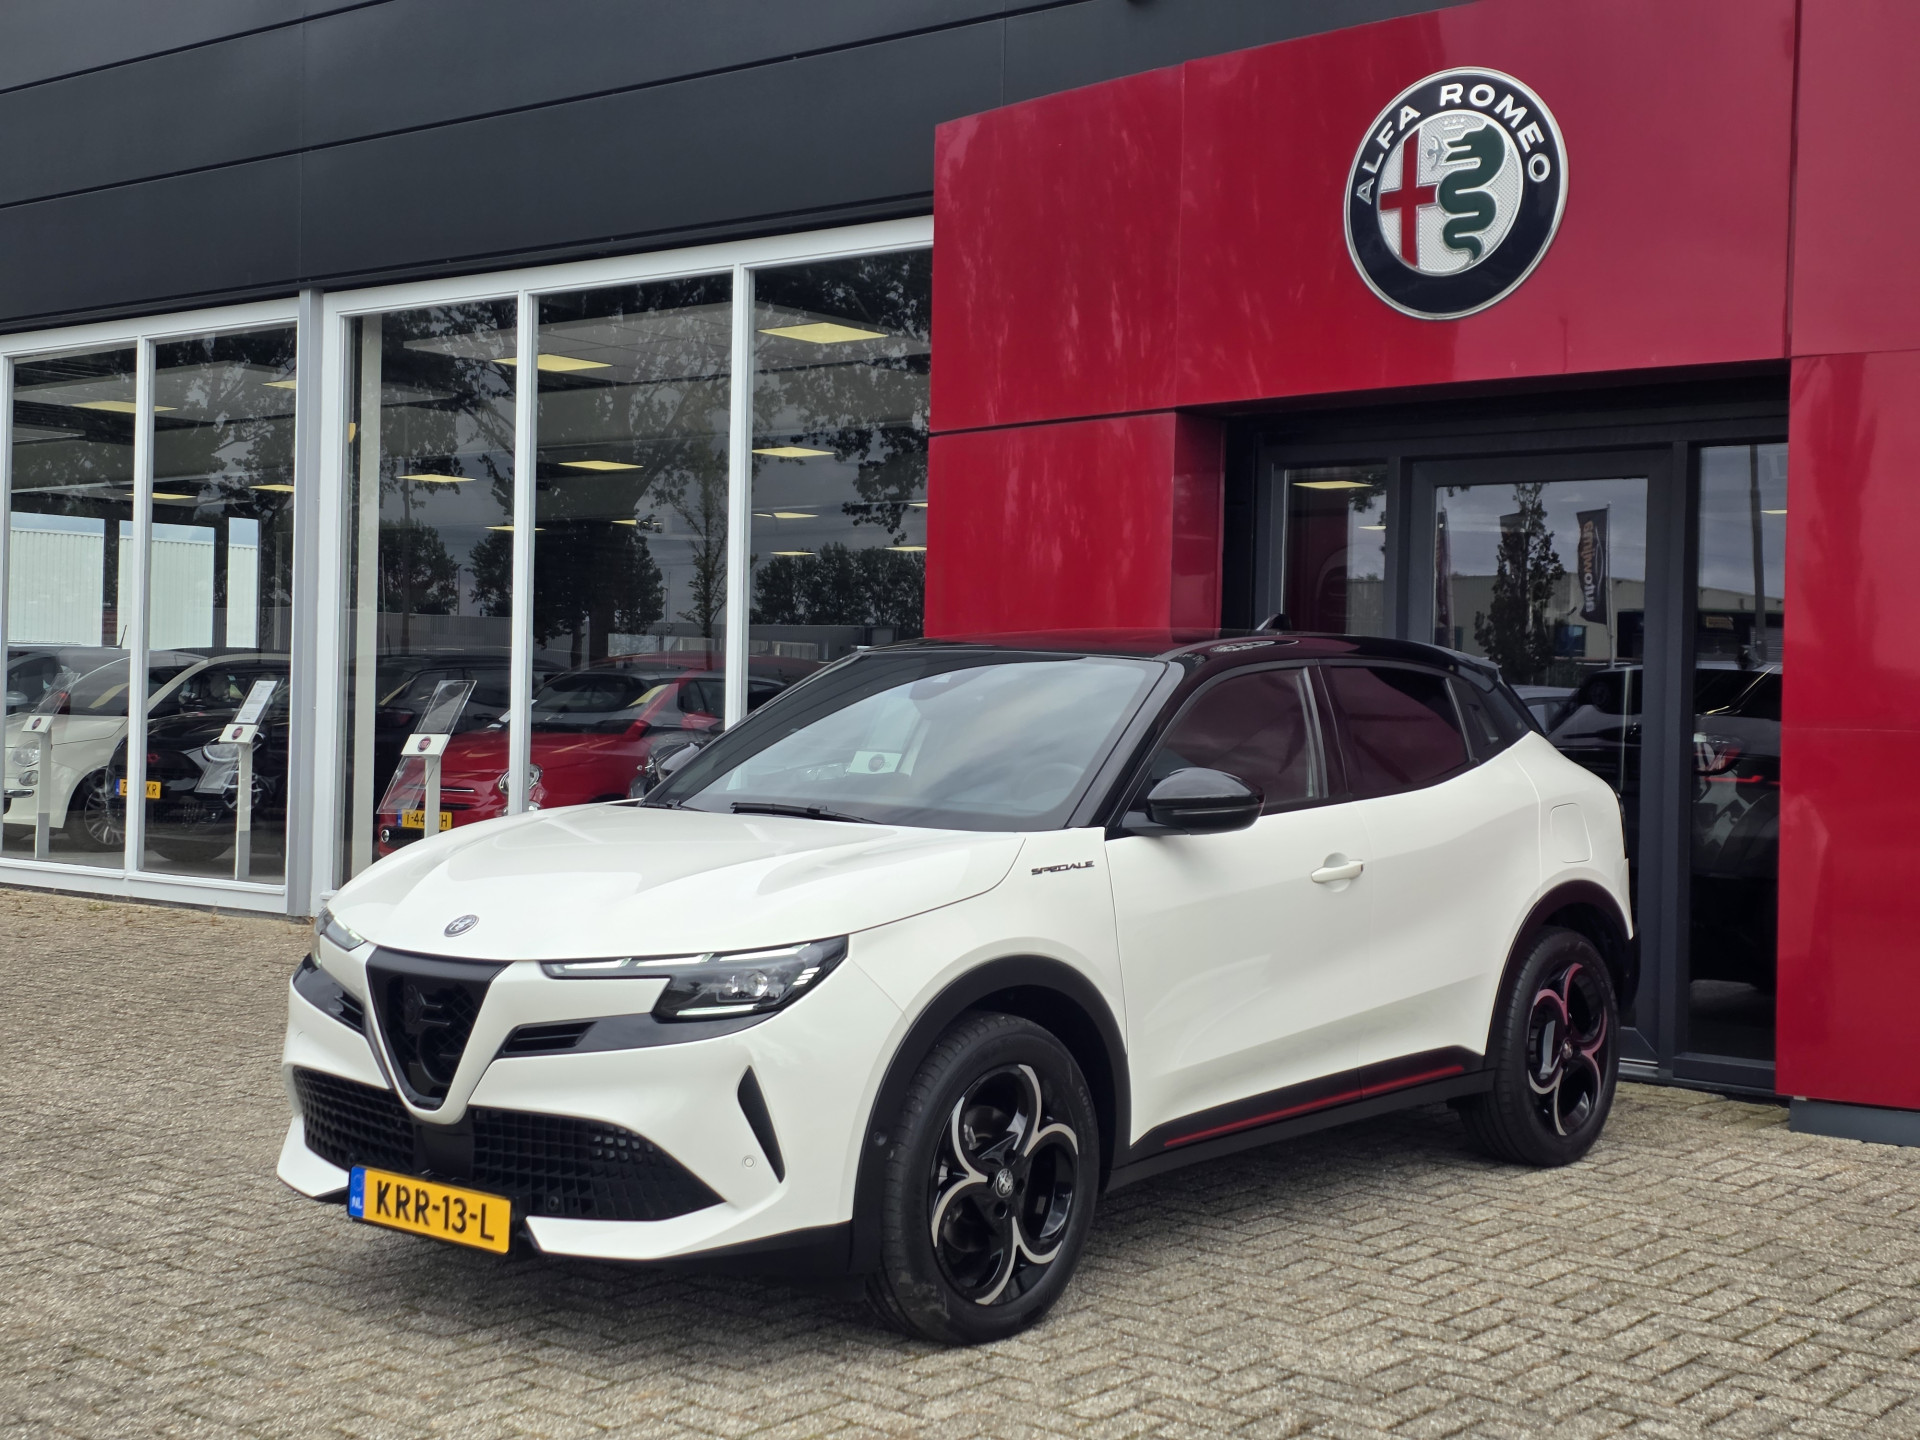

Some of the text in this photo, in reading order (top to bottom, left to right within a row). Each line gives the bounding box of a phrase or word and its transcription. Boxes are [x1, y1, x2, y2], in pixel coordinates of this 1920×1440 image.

[1356, 83, 1551, 205] ALFA ROMEO
[1031, 860, 1095, 876] SPECIALE
[351, 1180, 495, 1242] NL KRR-13-L
